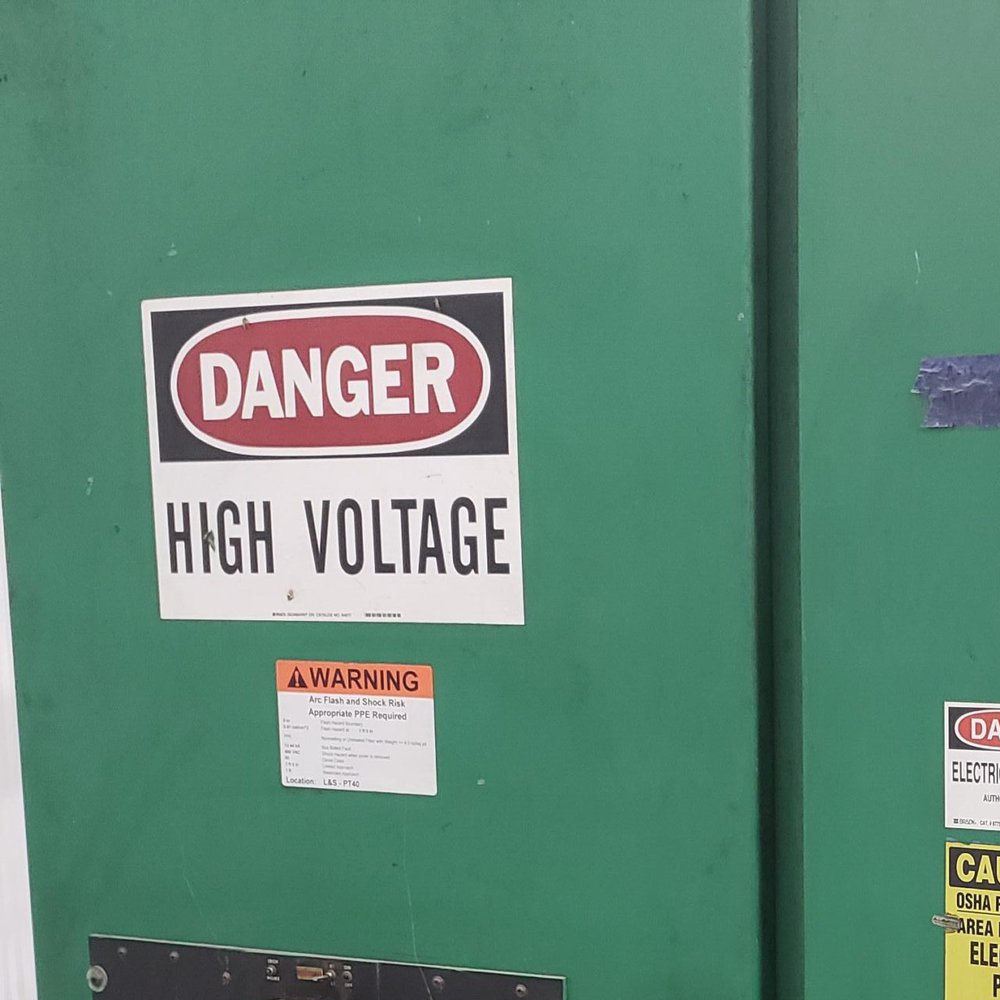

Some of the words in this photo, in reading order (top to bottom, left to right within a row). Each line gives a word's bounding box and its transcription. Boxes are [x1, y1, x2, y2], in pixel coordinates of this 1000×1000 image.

[200, 342, 456, 421] DANGER
[167, 500, 274, 574] HIGH
[303, 497, 510, 575] VOLTAGE
[310, 667, 418, 692] WARNING
[309, 696, 320, 704] Arc
[324, 697, 344, 705] Flash
[362, 698, 385, 707] Shock
[389, 699, 405, 707] Risk
[309, 708, 351, 718] Appropriate
[355, 710, 370, 718] PPE
[373, 711, 406, 721] Required
[956, 892, 991, 911] OSHA
[957, 918, 993, 937] AREA
